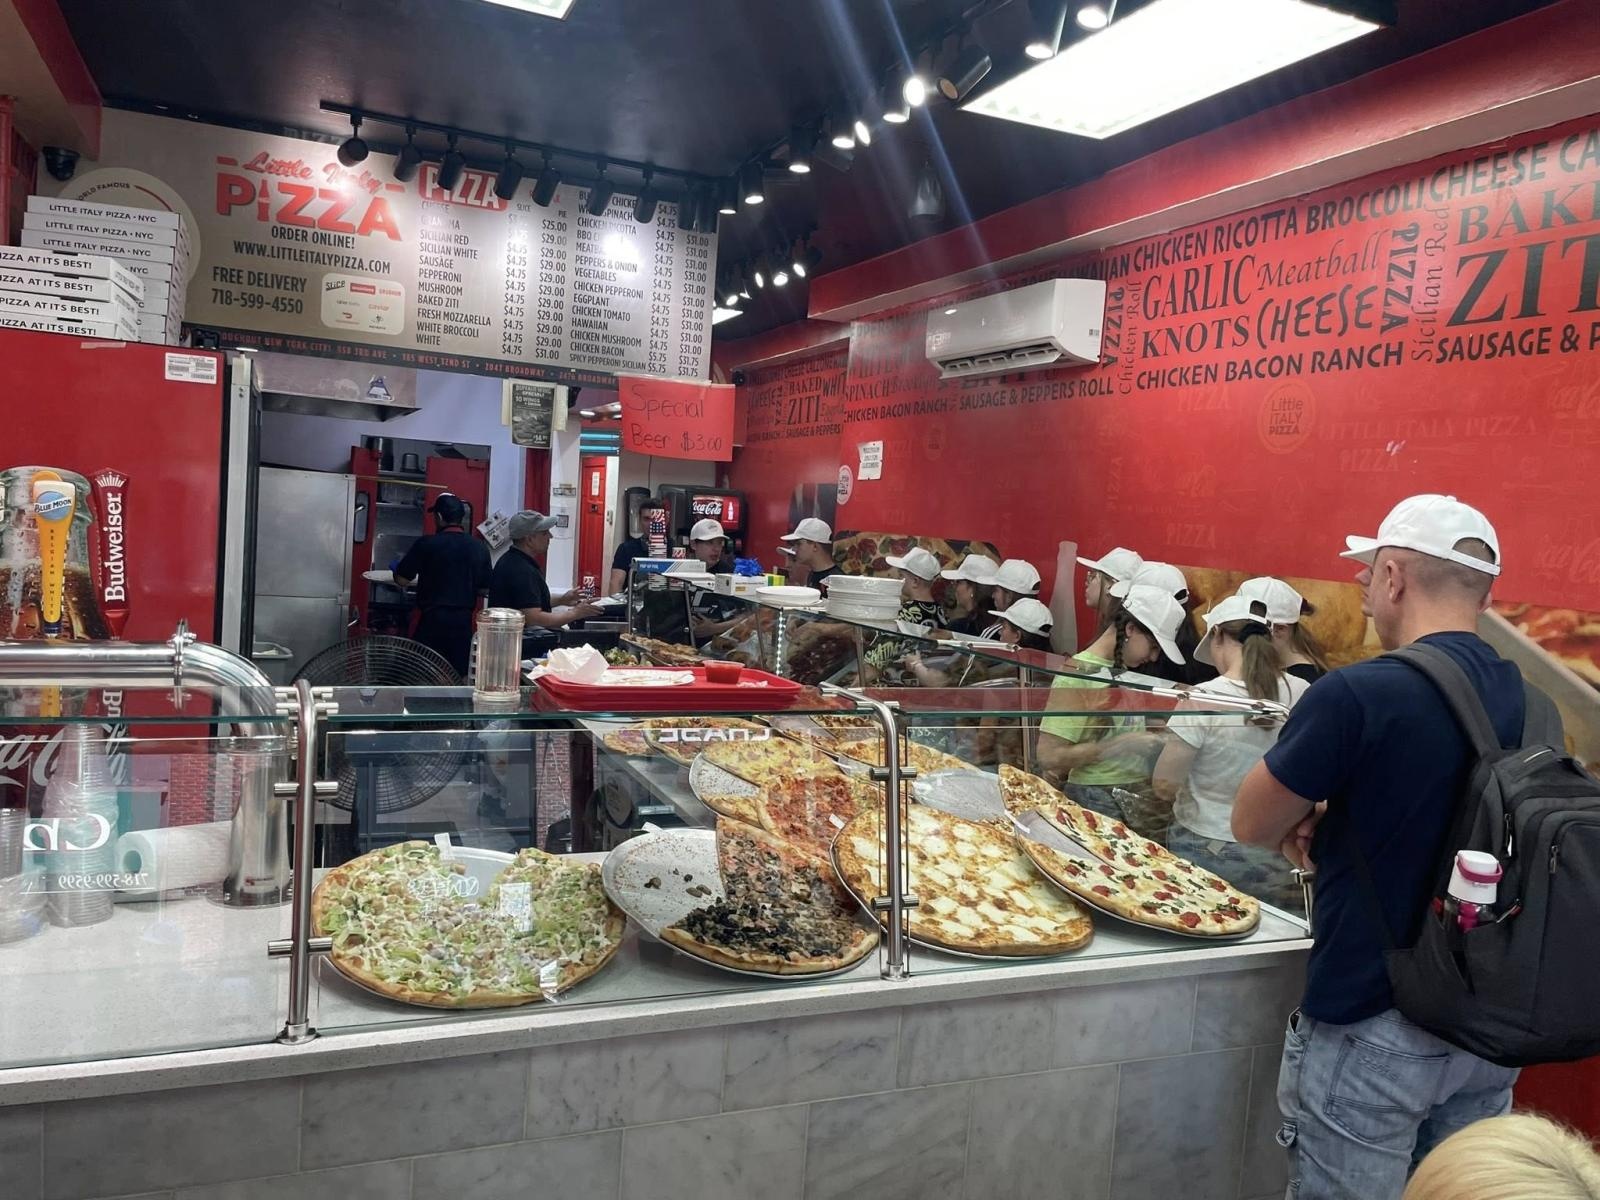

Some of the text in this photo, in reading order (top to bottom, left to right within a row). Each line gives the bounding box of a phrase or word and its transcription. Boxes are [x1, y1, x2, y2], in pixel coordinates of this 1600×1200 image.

[243, 151, 313, 178] Little
[97, 182, 130, 190] FAMOUS
[49, 204, 157, 223] LITTLE ITALY PIZZA NYC
[217, 173, 401, 241] PIZZA
[517, 203, 531, 212] SLICE
[559, 210, 567, 218] PIE
[612, 197, 637, 208] CHICKE
[1134, 141, 1547, 272] CHICKEN RICOTTA BROCCOLI CHEESE
[45, 221, 153, 240] LITTLE ITALY PIZZA NYC
[542, 219, 567, 231] $25.00
[577, 230, 591, 240] BBQ
[657, 217, 675, 228] $4.75
[43, 238, 151, 257] LITTLE ITALY PIZZA NYC
[272, 226, 355, 249] ORDER ONLINE!
[454, 235, 469, 245] RED
[541, 247, 566, 259] $29.00
[542, 233, 567, 246] $29.00
[656, 230, 675, 241] $4.75
[656, 235, 708, 253] $4.75 $31.00
[43, 257, 59, 265] ITS
[63, 259, 91, 269] BEST!
[233, 241, 390, 274] WWW.LITTLEITALYPIZZA.COM
[420, 242, 566, 272] SICILIAN WHITE $4.75 $29.00
[655, 254, 707, 270] $4.75 $31.00
[686, 246, 707, 258] $31.00
[1257, 229, 1390, 291] Meatball
[130, 266, 148, 274] NYC
[213, 266, 307, 293] FREE DELIVERY
[419, 255, 565, 284] SAUSAGE $4.75 $29.00
[575, 255, 605, 268] PEPPERS
[654, 267, 672, 277] $4.75
[684, 271, 706, 282] $31.00
[1380, 222, 1421, 335] PIZZA
[44, 280, 60, 288] ITS
[64, 282, 93, 292] BEST!
[419, 268, 565, 297] PEPPERONI $4.75 $29.00
[574, 281, 704, 307] CHICKEN PEPPERONI $4.75 $31.00
[575, 268, 705, 295] VEGETABLES $4.75 $31.00
[1143, 255, 1256, 320] GARLIC
[212, 289, 303, 314] 718-599-4550
[418, 281, 564, 309] MUSHROOM $4.75 $29.00
[574, 294, 703, 320] EGGPLANT $4.75 $31.00
[50, 303, 66, 311] ITS
[71, 305, 99, 315] BEST!
[418, 294, 563, 322] BAKED ZITI $4.75 $29.00
[572, 306, 703, 331] CHICKEN TOMATO $4.75 $31.00
[1257, 284, 1378, 349] CHEESE
[1412, 267, 1444, 362] Sicilian
[68, 326, 96, 335] BEST!
[418, 308, 562, 335] FRESH MOZZARELLA $4.75 $29.00
[572, 318, 702, 343] HAWAIIAN $4.75 $31.00
[1101, 287, 1125, 368] PIZZA
[416, 334, 559, 360] WHITE $4.75 $31.00
[417, 321, 561, 348] WHITE BROCCOLI $4.75 $29.00
[571, 330, 701, 355] CHICKEN MUSHROOM $4.75 $31.00
[1119, 281, 1142, 394] Chicken Roll
[1140, 316, 1250, 359] KNOTS
[1435, 323, 1580, 364] SAUSAGE &
[571, 342, 698, 366] CHICKEN BACON $5.75 $31.75
[588, 356, 698, 377] PEPPERONI SICILIAN $5.75 $31.75
[1137, 341, 1404, 389] CHICKEN BACON RANCH
[626, 383, 703, 421] Special
[959, 377, 1114, 410] SAUSAGE PEPPERS ROLL
[1270, 398, 1304, 412] Little
[788, 395, 819, 425] ZITI
[880, 399, 947, 418] BACON RANCH
[1269, 411, 1304, 426] ITALY
[631, 423, 670, 449] Beer
[34, 498, 71, 512] BLUE MOON
[104, 493, 124, 602] Budweiser
